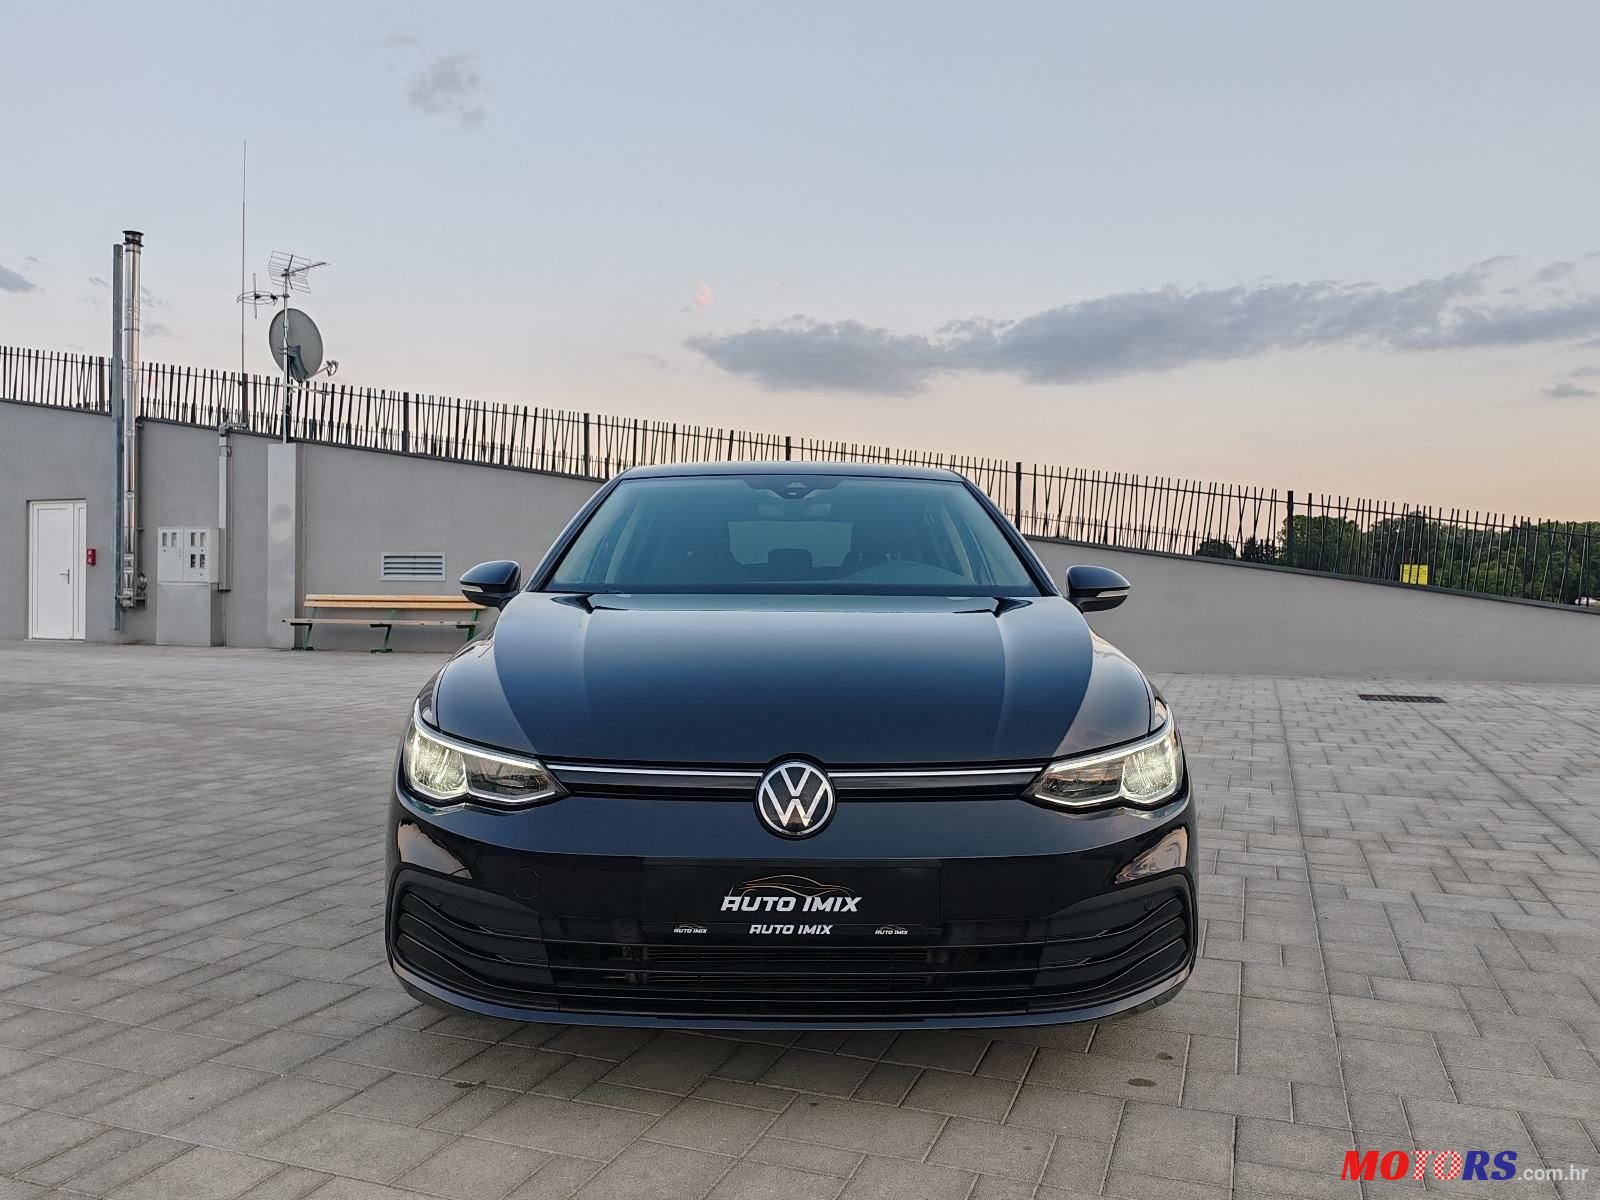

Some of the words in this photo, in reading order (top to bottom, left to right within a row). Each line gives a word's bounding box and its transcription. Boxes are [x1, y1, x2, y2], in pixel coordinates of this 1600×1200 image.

[720, 896, 797, 912] AUTO
[801, 896, 863, 912] IMIX
[749, 924, 795, 935] AUTO
[797, 924, 833, 935] IMIX
